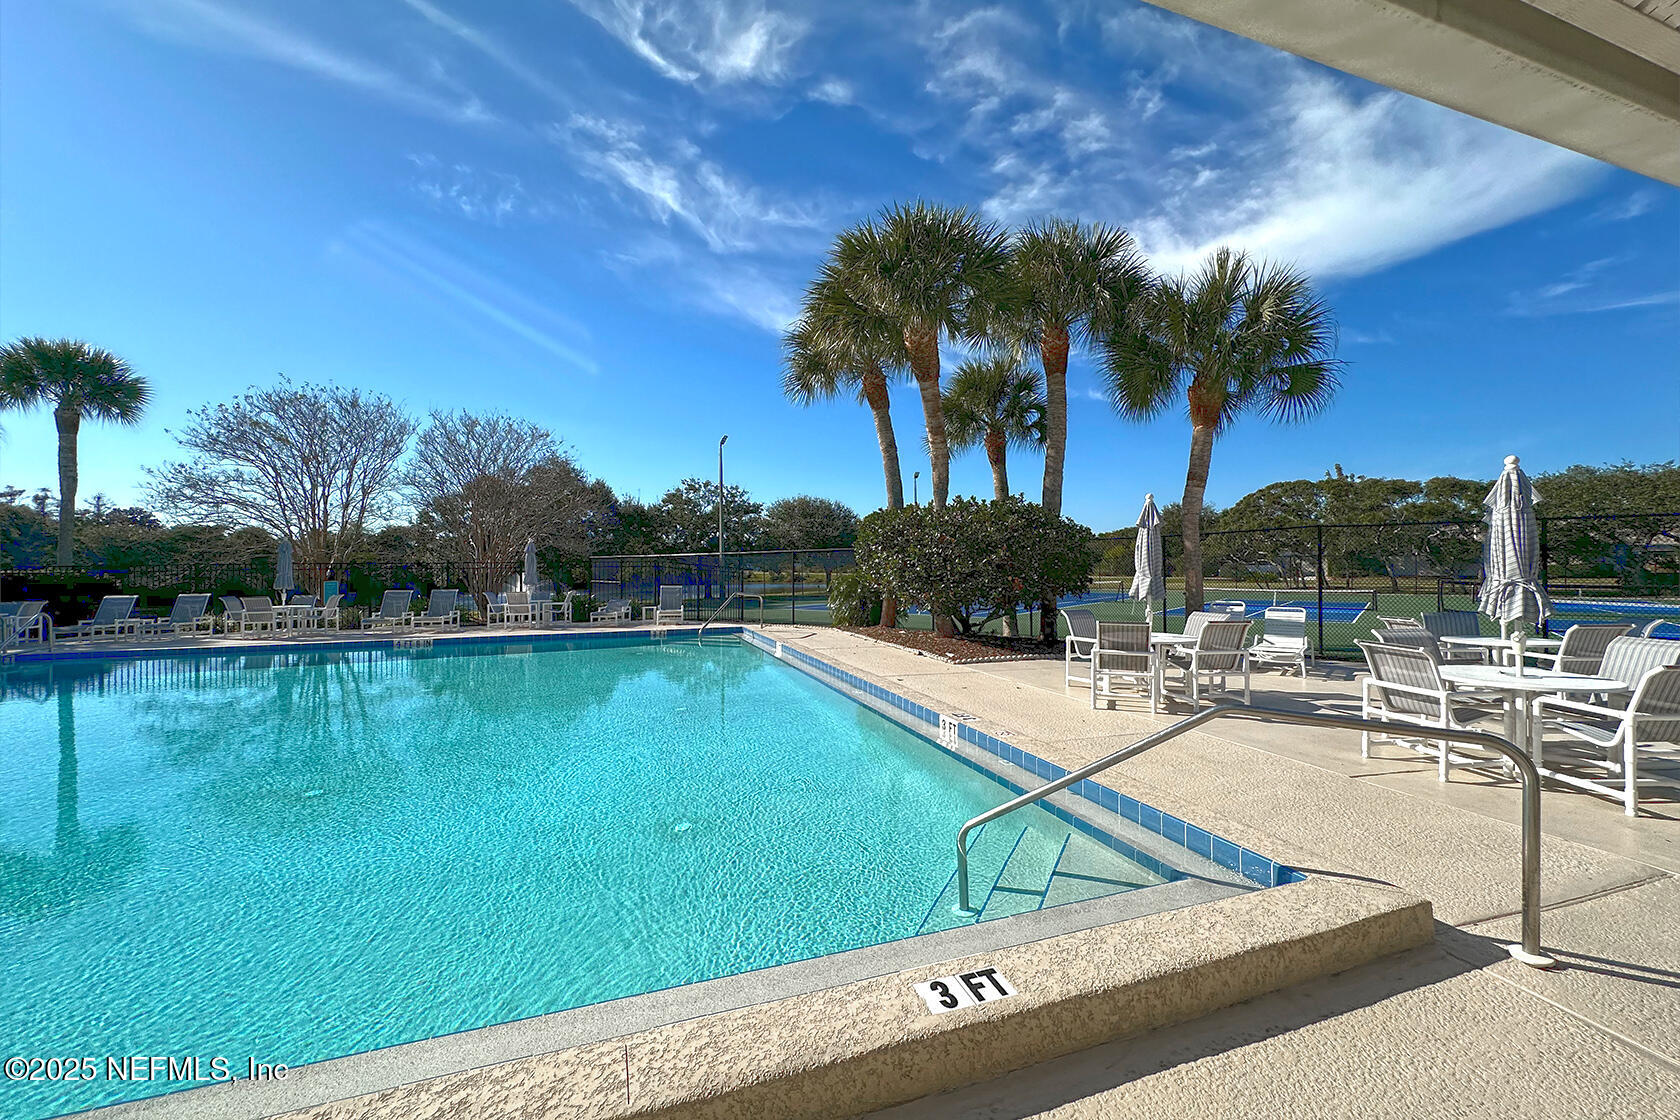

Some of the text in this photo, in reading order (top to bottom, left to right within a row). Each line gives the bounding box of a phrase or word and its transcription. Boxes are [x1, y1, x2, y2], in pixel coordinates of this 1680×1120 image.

[942, 719, 956, 735] 3 FT
[929, 967, 1009, 1009] 3 FT
